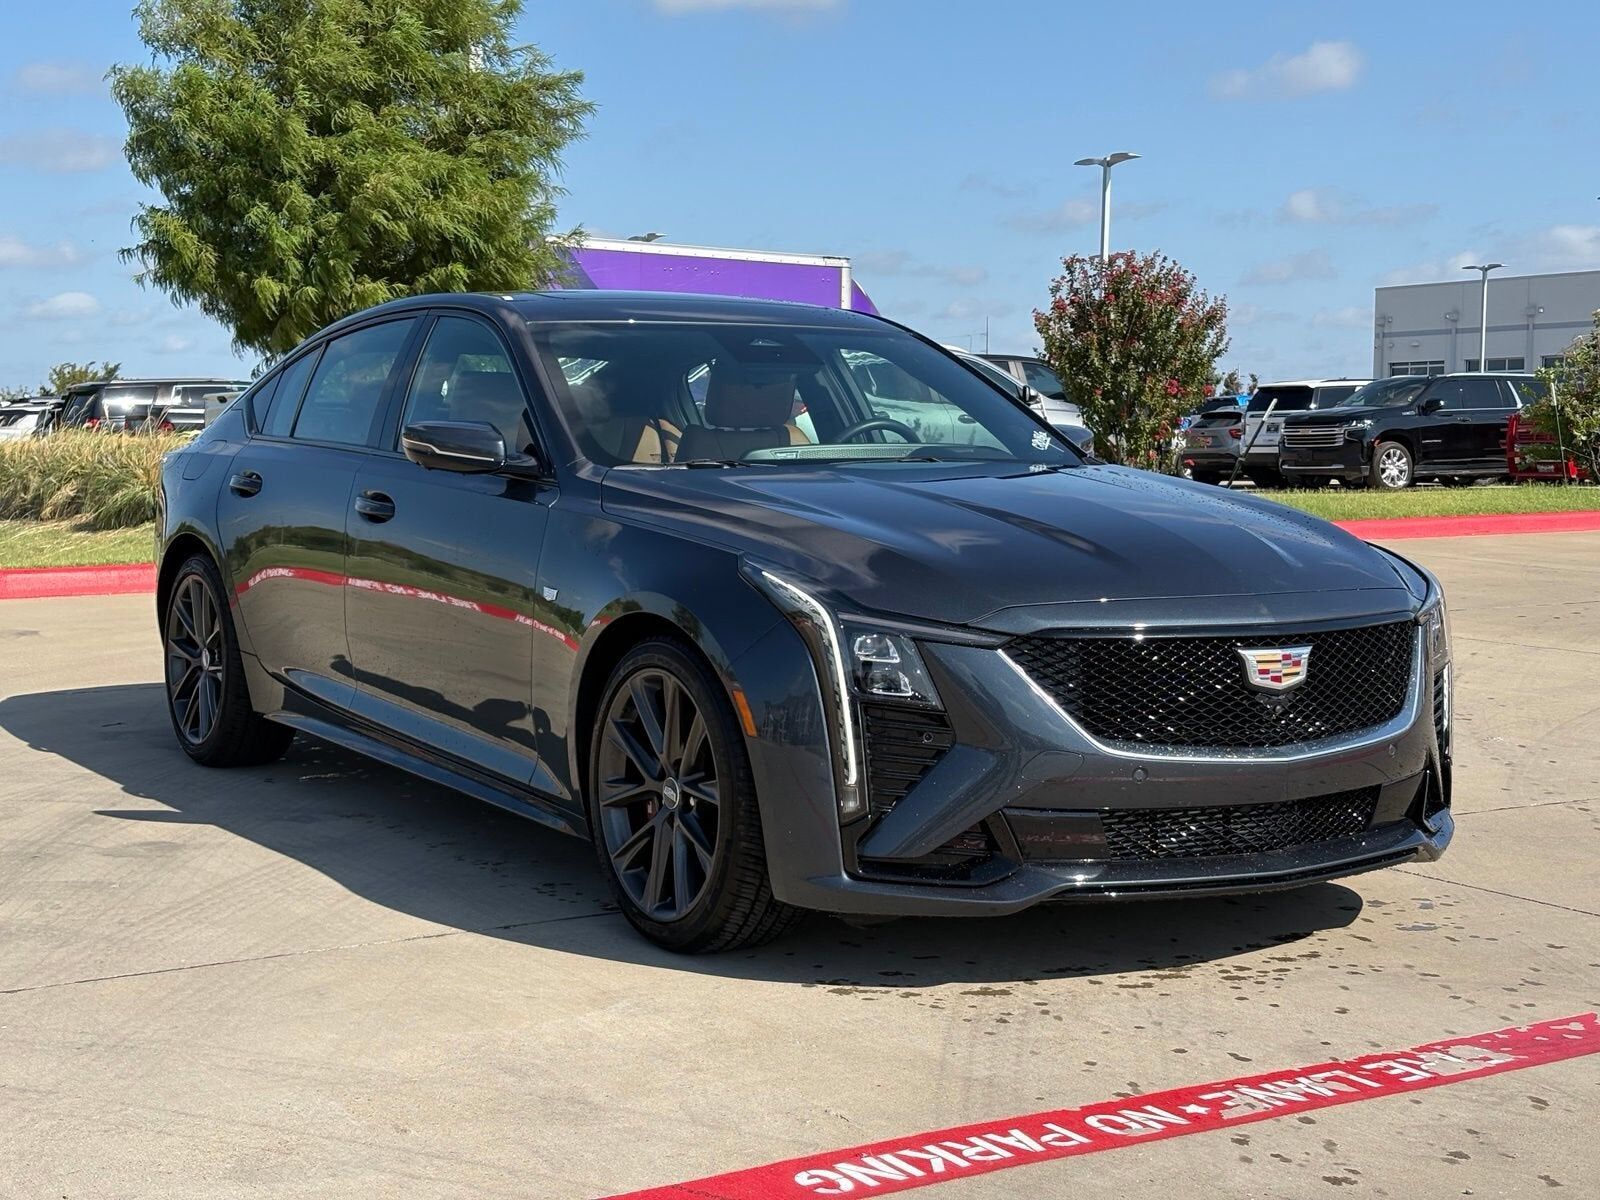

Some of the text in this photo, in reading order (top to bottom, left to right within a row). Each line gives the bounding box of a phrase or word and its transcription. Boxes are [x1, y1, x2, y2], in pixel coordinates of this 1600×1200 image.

[1199, 1069, 1384, 1119] LANE
[1084, 1104, 1192, 1136] NO
[794, 1123, 1092, 1195] PARKING
